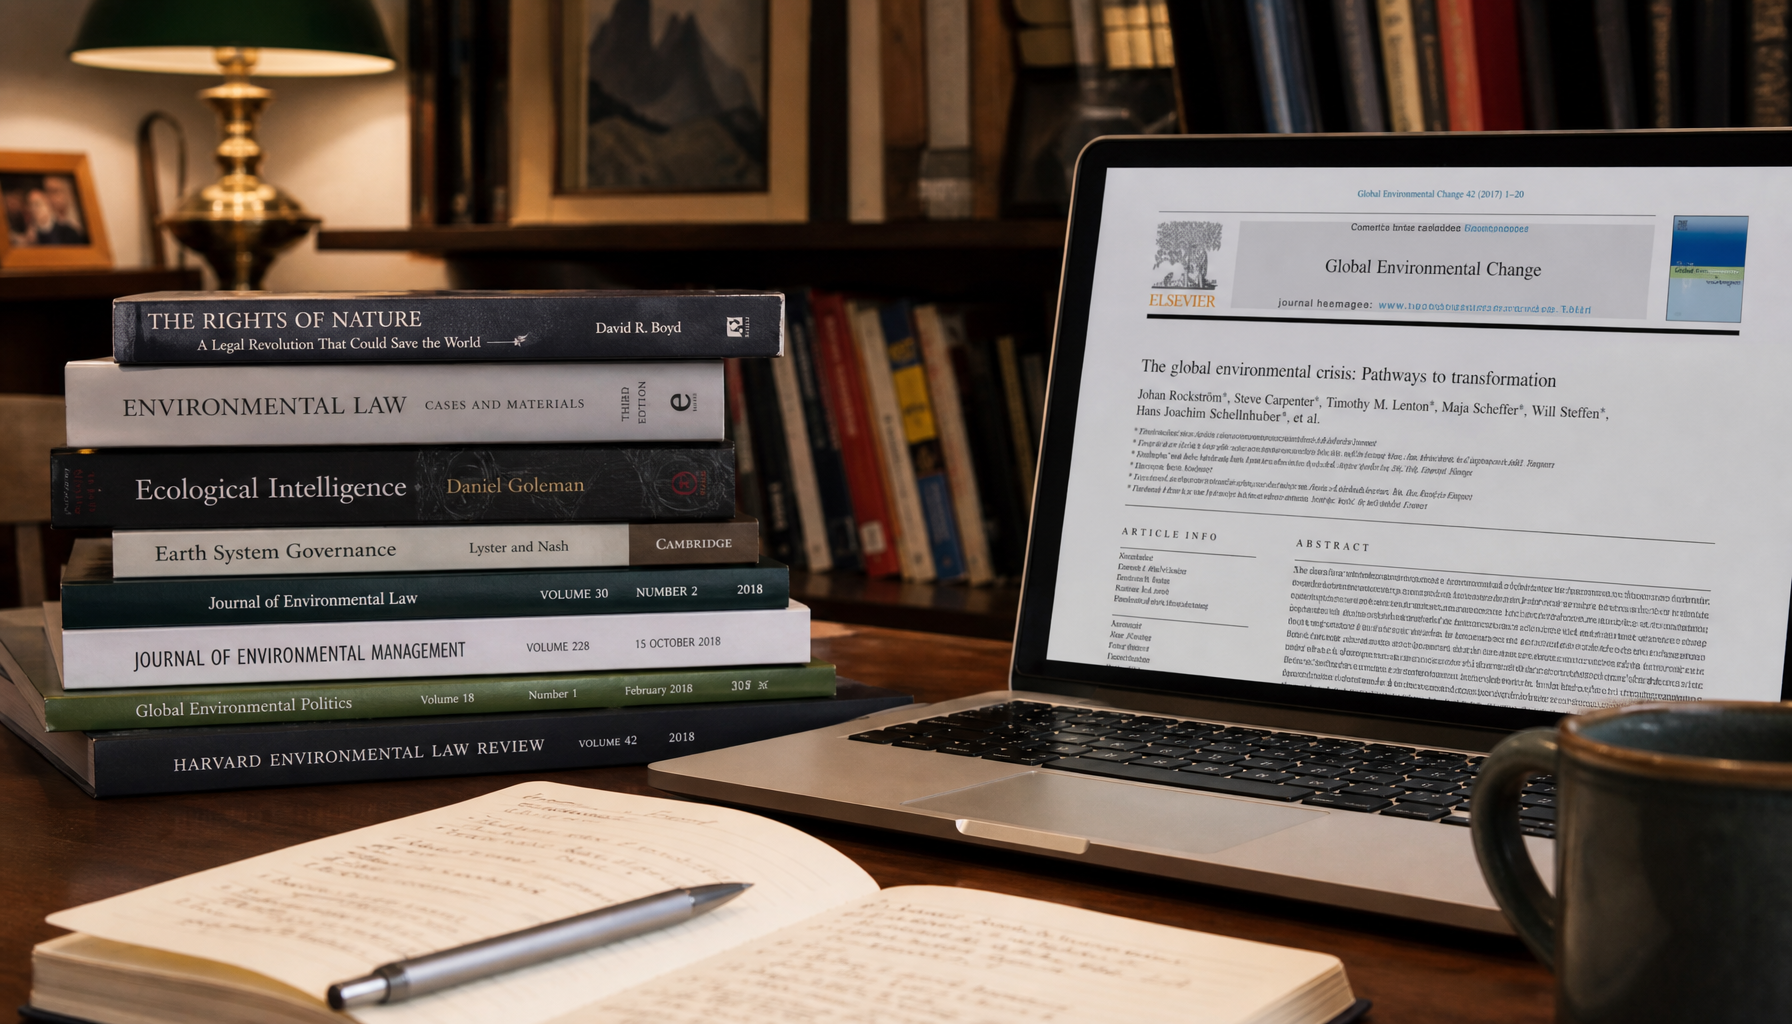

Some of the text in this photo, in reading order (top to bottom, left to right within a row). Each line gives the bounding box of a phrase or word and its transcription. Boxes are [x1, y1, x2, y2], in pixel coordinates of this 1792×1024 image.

[1383, 190, 1434, 198] Environmental
[1437, 190, 1464, 200] Change
[1478, 191, 1502, 199] (2017)
[1326, 259, 1541, 280] Global Environmental Change
[1150, 294, 1215, 307] ELSEVIER
[1278, 299, 1313, 308] journal
[148, 311, 421, 329] THE RIGHTS OF NATURE
[596, 321, 681, 336] David R. Boyd
[198, 336, 481, 354] A Legal Revolution That Could Save the World
[1142, 359, 1556, 387] The global environmental crisis: Pathways to transformation
[124, 397, 584, 416] ENVIRONMENTAL LAW CASES AND MATERIALS
[671, 394, 691, 411] e
[1138, 389, 1165, 400] Johan
[1234, 393, 1261, 404] Steve
[1327, 397, 1370, 412] Timothy
[1374, 399, 1388, 409] M.
[1442, 402, 1468, 416] Maja
[1533, 405, 1555, 417] Will
[1137, 405, 1160, 416] Hans
[1164, 407, 1205, 418] Joachim
[1294, 414, 1303, 423] et
[1307, 413, 1320, 423] al.
[136, 476, 406, 506] Ecological Intelligence
[448, 477, 584, 493] Daniel Goleman
[1122, 528, 1216, 540] ARTICLE INFO
[470, 540, 568, 556] Lyster and Nash
[1296, 540, 1368, 551] ABSTRACT
[156, 544, 396, 565] Earth System Governance
[540, 589, 608, 599] VOLUME 30
[637, 586, 697, 597] NUMBER 2
[738, 584, 762, 594] 2018
[209, 592, 417, 609] Journal of Environmental Law
[527, 641, 589, 652] VOLUME 228
[636, 637, 720, 648] 15 OCTOBER 2018
[134, 642, 465, 672] JOURNAL OF ENVIRONMENTAL MANAGEMENT
[529, 689, 576, 700] Number 1
[626, 684, 692, 696] February 2018
[421, 693, 474, 704] Volume 18
[136, 697, 352, 717] Global Environmental Politics
[579, 736, 637, 747] VOLUME 42
[669, 732, 694, 742] 2018
[174, 739, 544, 771] HARVARD ENVIRONMENTAL LAW REVIEW
